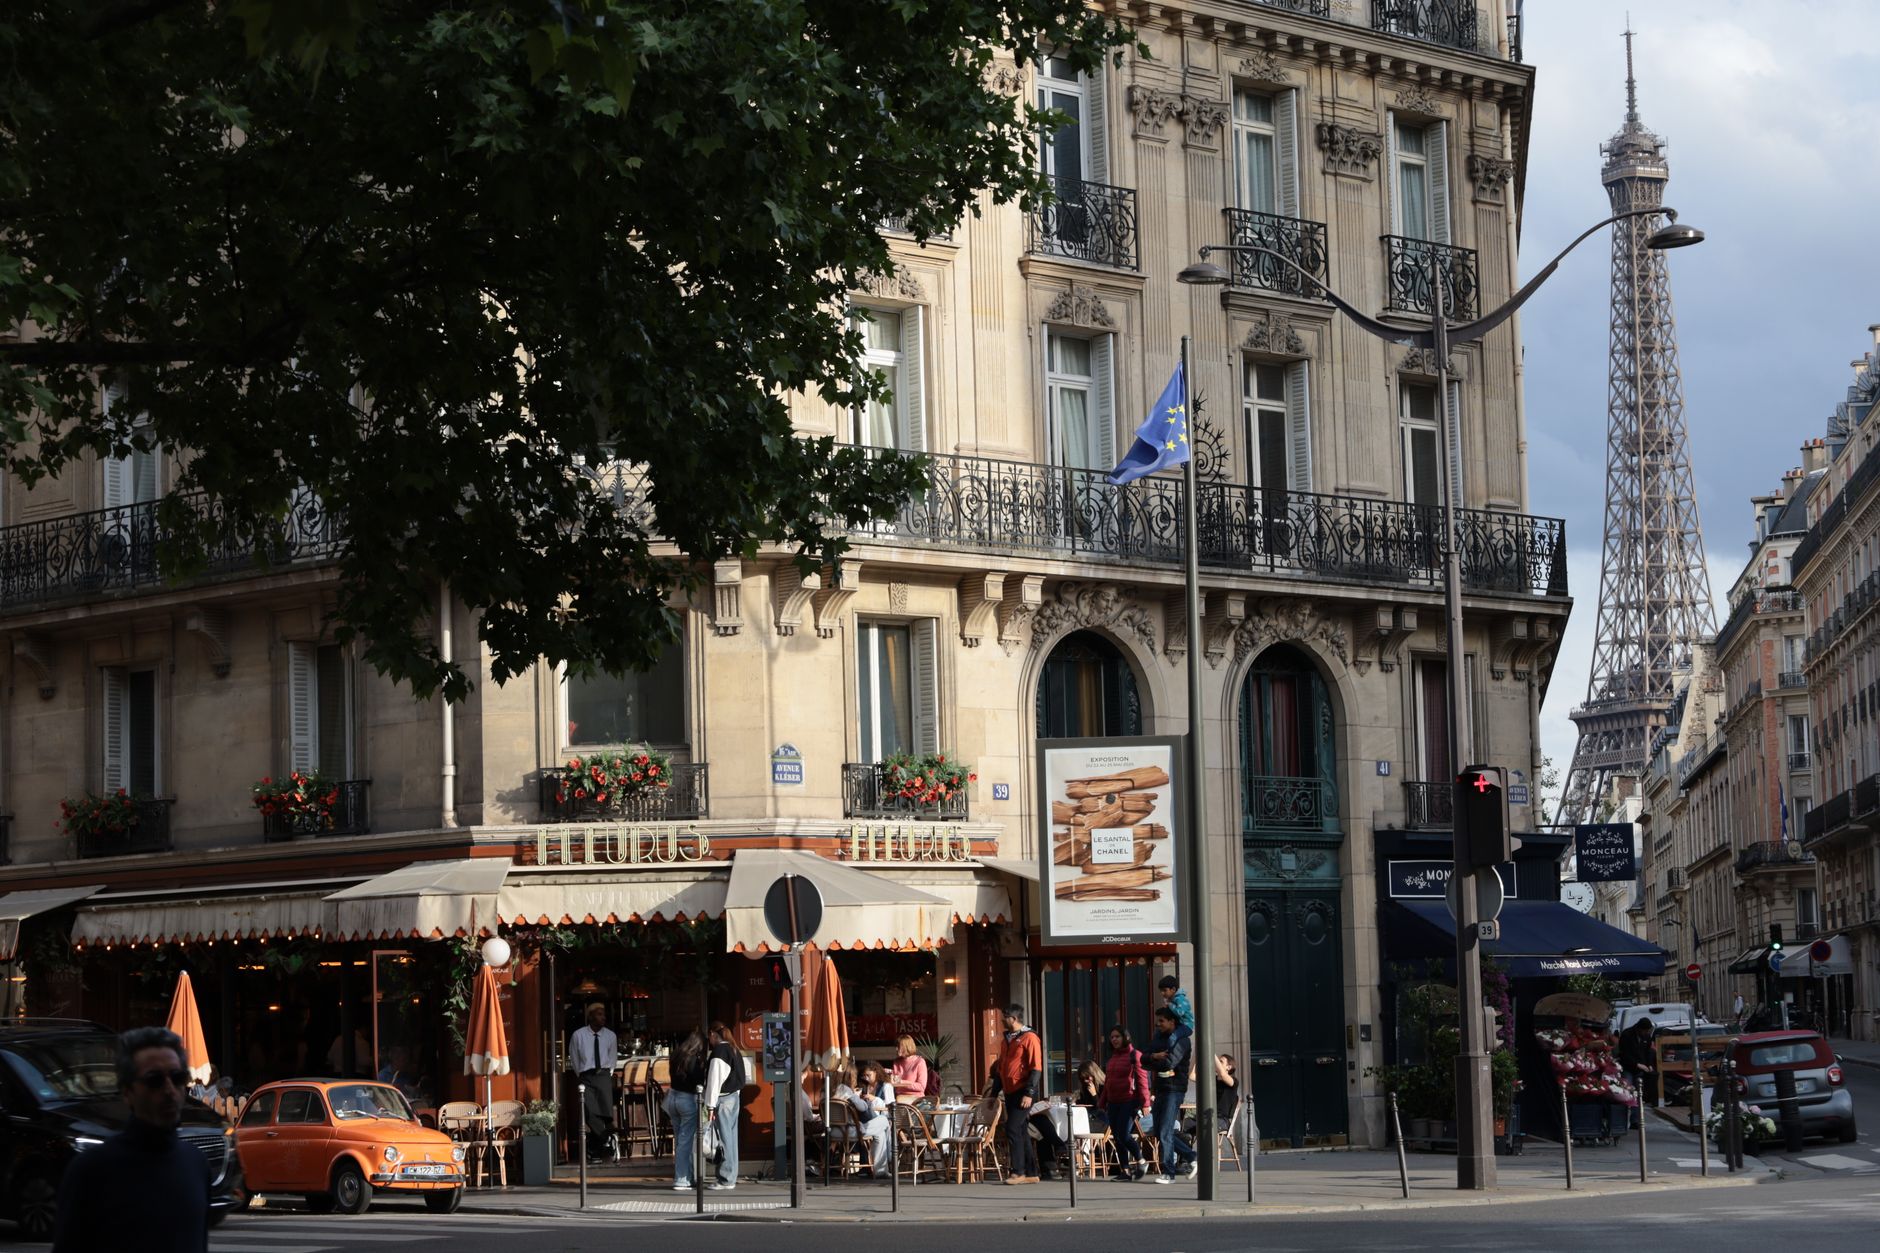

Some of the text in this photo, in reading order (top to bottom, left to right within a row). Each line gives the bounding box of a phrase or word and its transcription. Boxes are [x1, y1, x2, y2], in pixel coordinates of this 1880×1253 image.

[775, 764, 800, 772] AVENUE
[1379, 761, 1389, 775] 41
[774, 771, 801, 782] KLÉBER
[995, 783, 1008, 799] 39
[536, 823, 710, 866] FLEURUS
[852, 825, 971, 862] FLEURUS
[1096, 847, 1129, 855] CHANEL
[1581, 847, 1629, 856] MONCEAU
[1481, 925, 1492, 936] 39
[1540, 959, 1566, 970] Marché
[1582, 958, 1604, 969] depuis
[1603, 957, 1621, 966] 1965
[894, 1017, 928, 1033] TASSE
